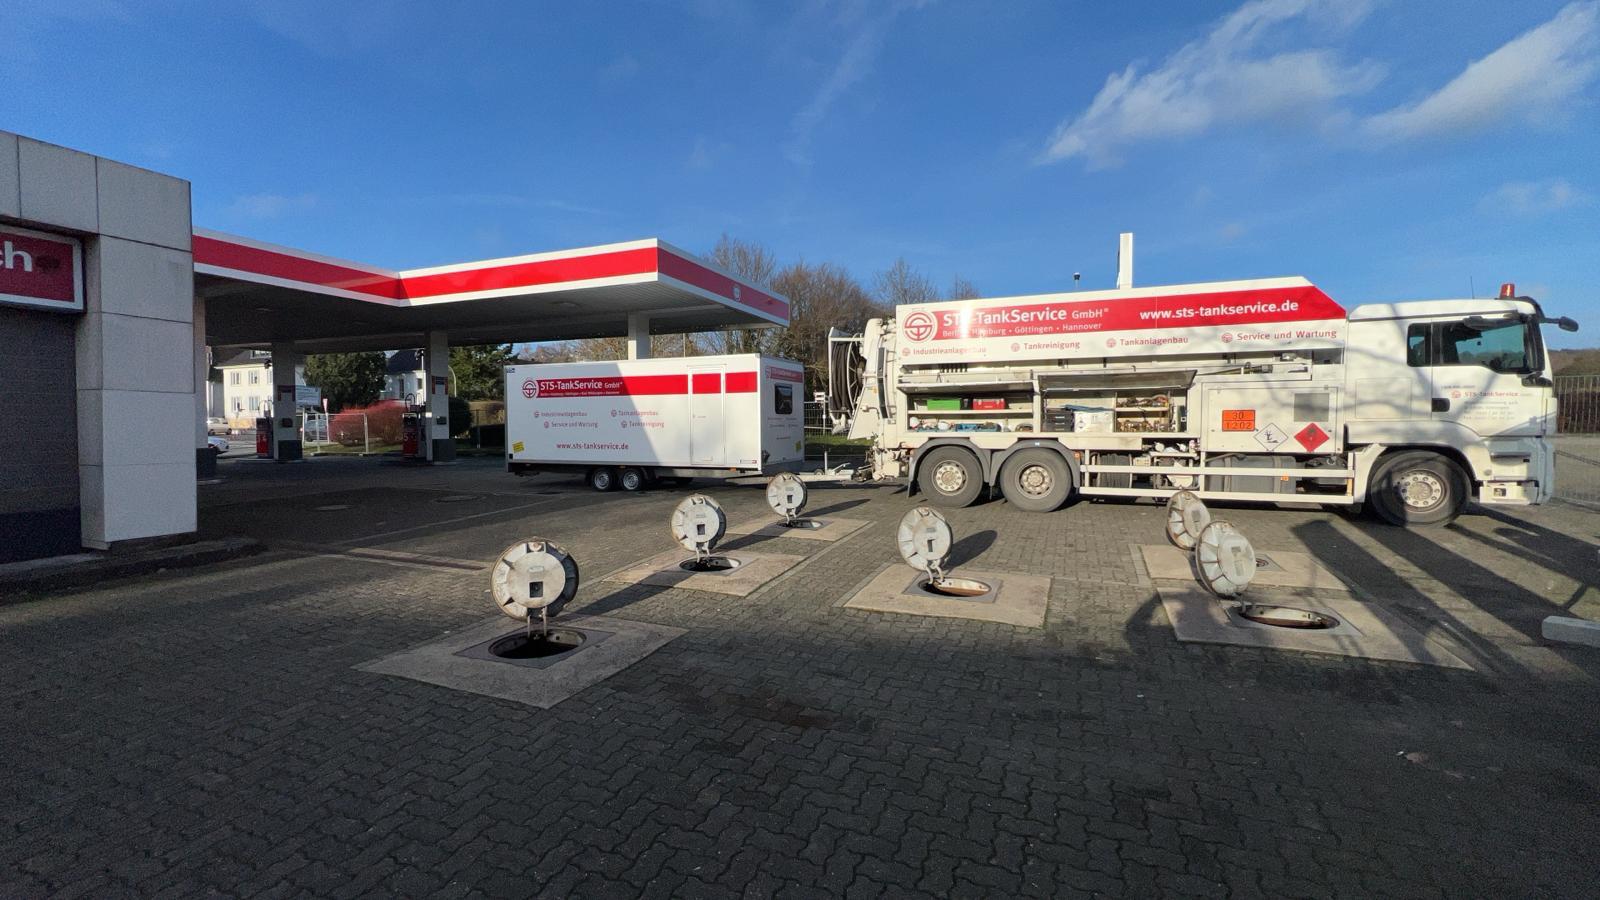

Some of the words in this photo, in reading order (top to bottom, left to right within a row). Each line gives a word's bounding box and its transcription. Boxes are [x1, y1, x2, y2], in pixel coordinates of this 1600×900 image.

[0, 240, 33, 272] h
[1139, 300, 1299, 320] www.sts-tankservice.de
[943, 307, 1067, 327] ST-TankService
[1014, 325, 1053, 334] Göttingen
[1062, 323, 1102, 331] Hannover
[1237, 332, 1271, 341] Service
[1274, 331, 1292, 340] und
[1295, 330, 1337, 339] Wartung
[1024, 341, 1080, 350] Tankreinigung
[1120, 336, 1189, 346] Tankanlagenbau
[913, 346, 987, 355] Industrieanlagau
[540, 379, 602, 391] STS-TankService
[1232, 411, 1245, 420] 30
[1226, 421, 1252, 430] 1202
[556, 442, 629, 450] www.sts-tankservice.de
